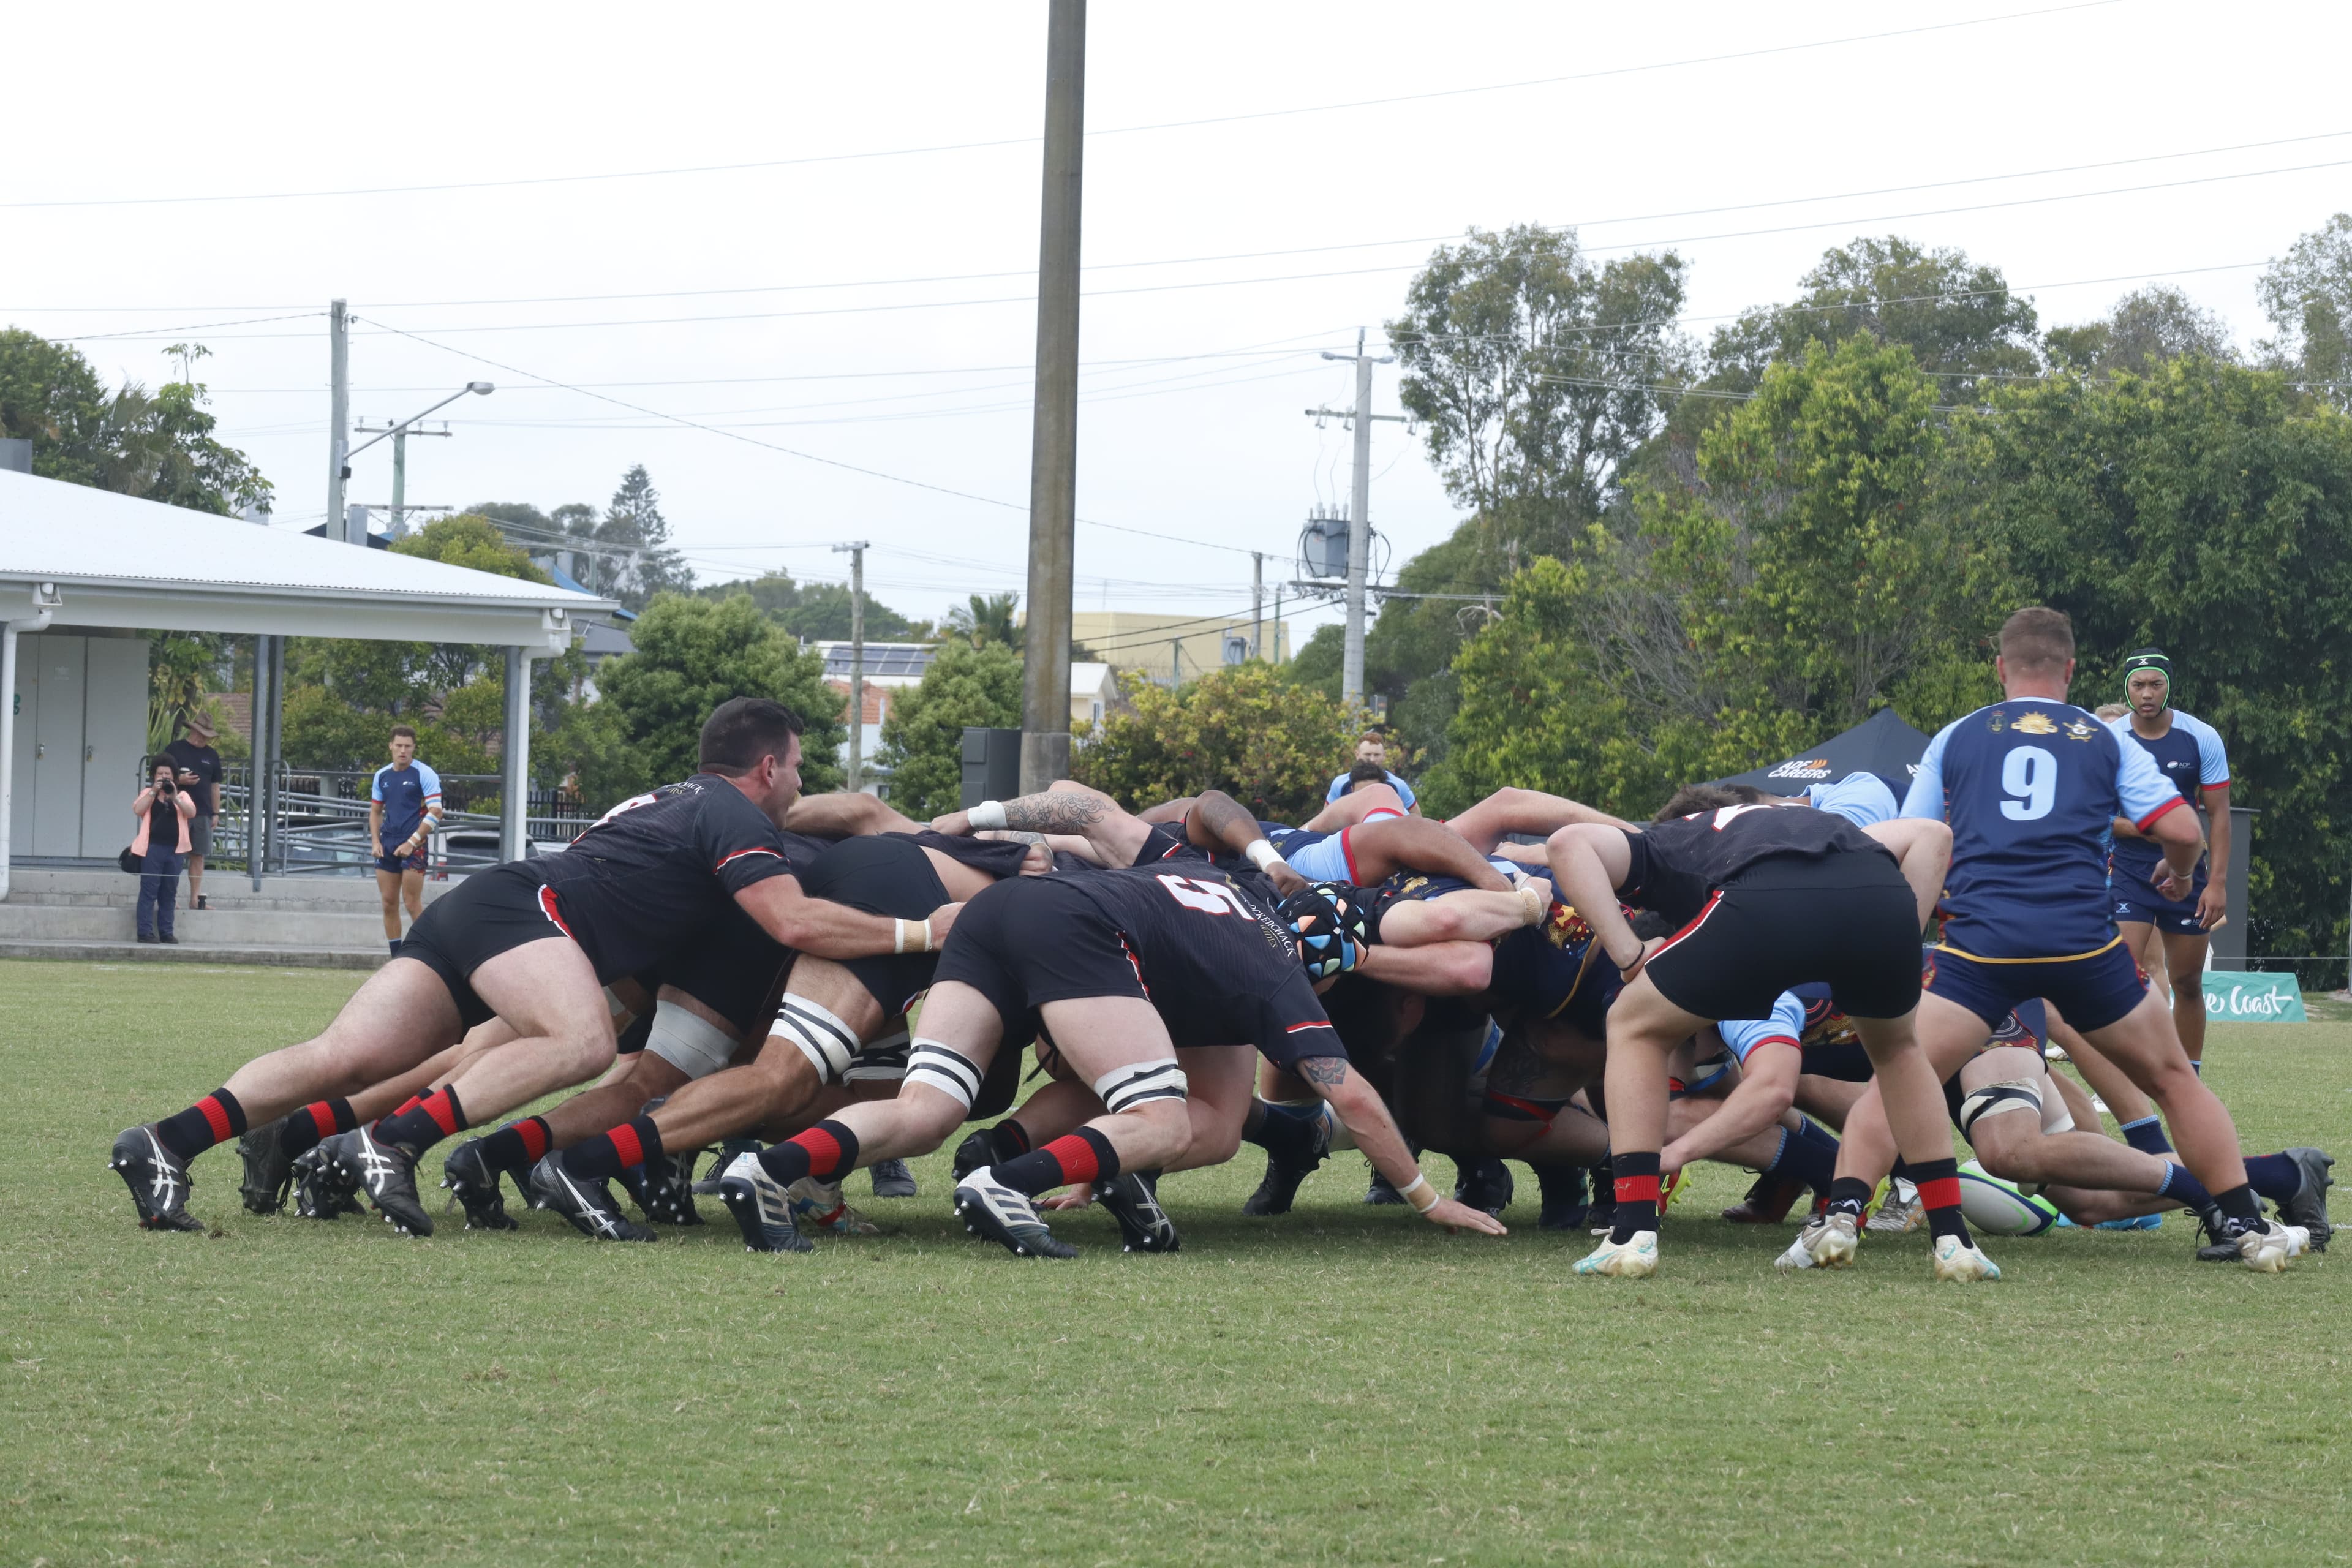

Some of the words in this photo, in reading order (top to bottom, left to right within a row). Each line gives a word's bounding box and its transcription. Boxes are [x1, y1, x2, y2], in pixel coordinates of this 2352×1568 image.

[1768, 769, 1832, 778] CAREERS
[1779, 760, 1813, 769] ADF
[2000, 745, 2057, 821] 9
[1155, 874, 1256, 921] 5
[2230, 985, 2294, 1015] Coast
